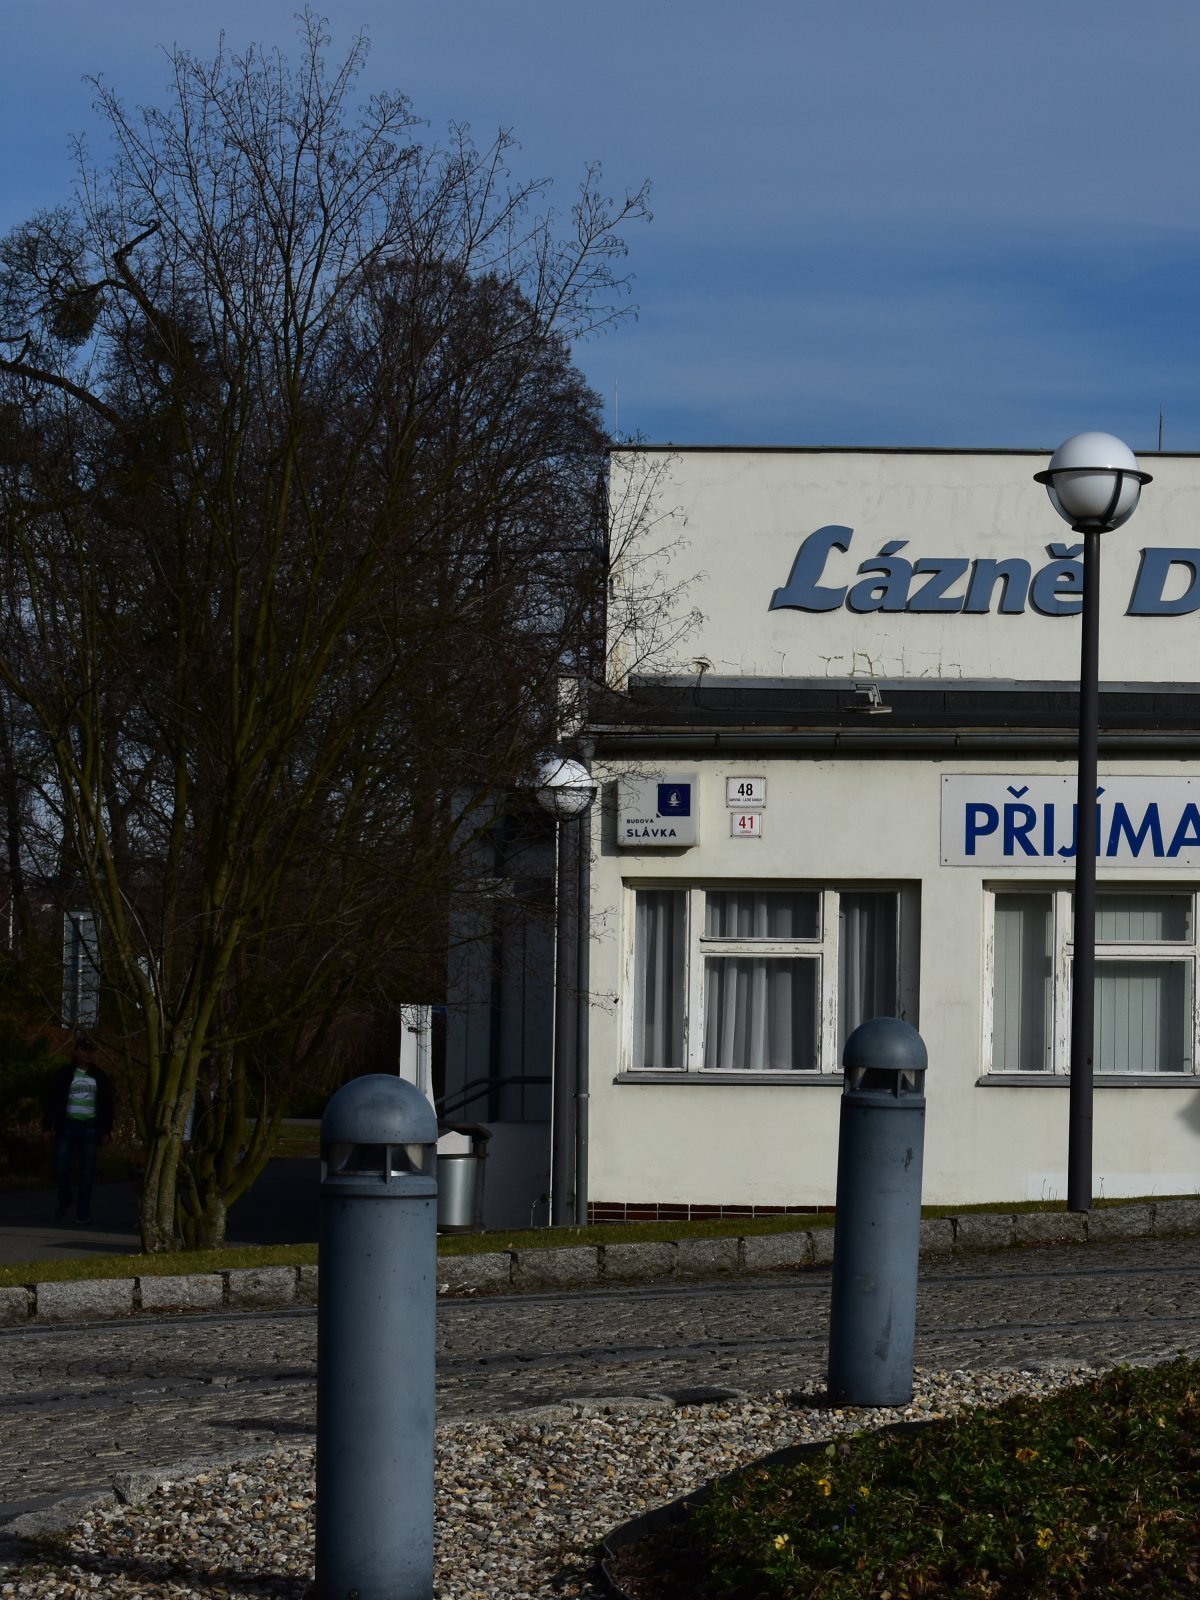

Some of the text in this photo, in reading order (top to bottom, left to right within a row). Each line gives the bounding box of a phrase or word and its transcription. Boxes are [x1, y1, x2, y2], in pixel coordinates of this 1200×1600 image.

[769, 525, 1084, 617] Lázně
[737, 783, 753, 796] 48
[738, 815, 754, 829] 41
[626, 826, 677, 838] SLÁVKA
